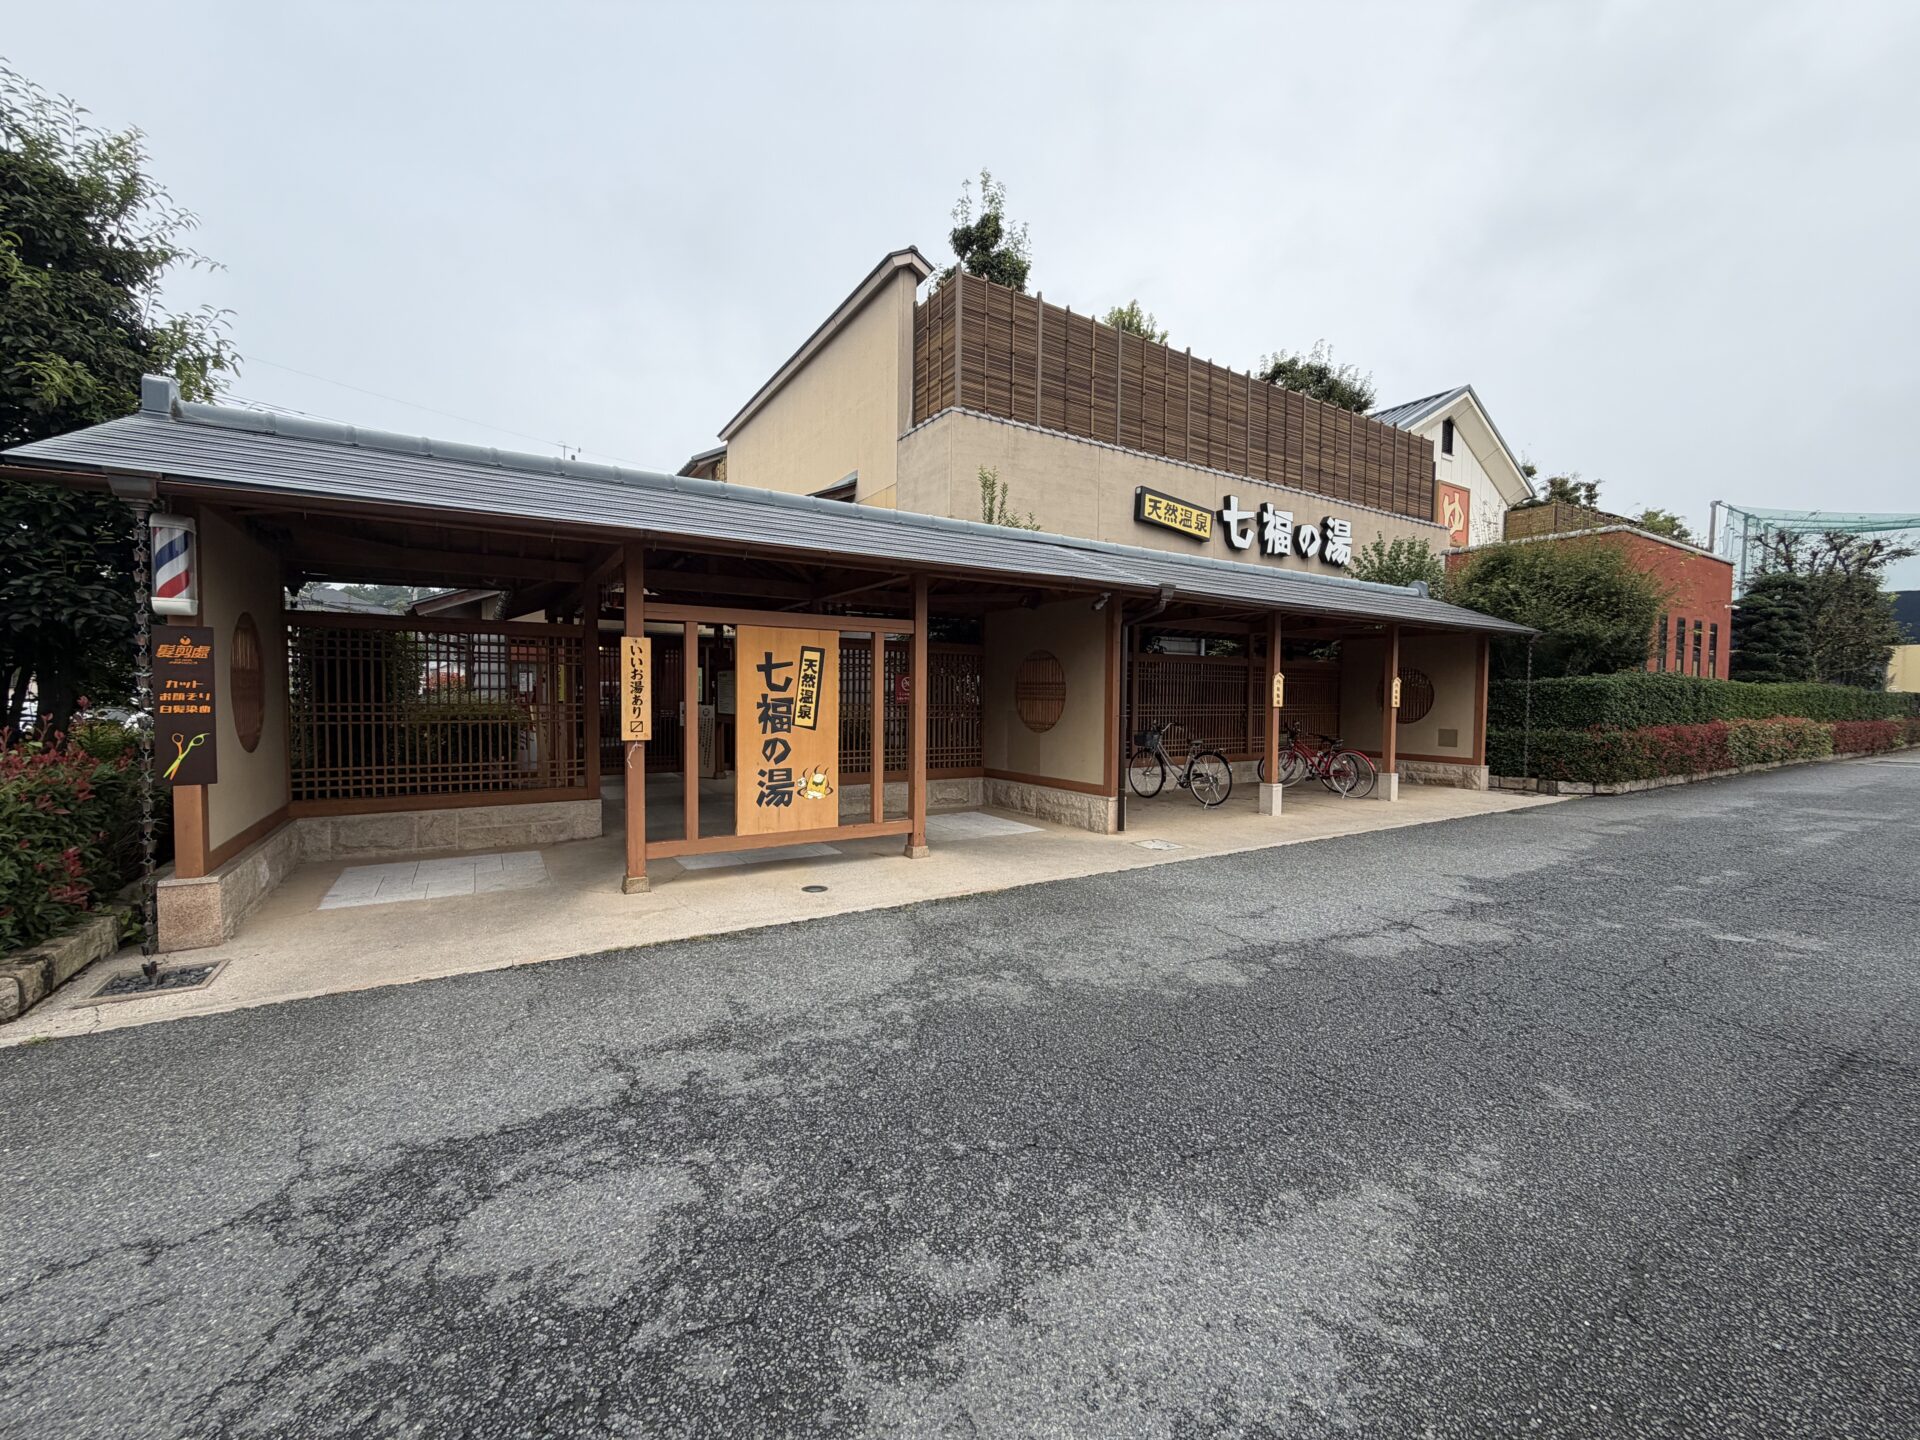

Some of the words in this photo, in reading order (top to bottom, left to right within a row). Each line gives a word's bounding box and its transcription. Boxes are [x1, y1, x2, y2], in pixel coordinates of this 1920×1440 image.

[1147, 497, 1210, 533] 天然温泉
[1218, 494, 1354, 566] 七福の湯
[165, 679, 204, 689] カット
[796, 658, 818, 720] 天然温泉
[756, 651, 795, 808] 七福の湯
